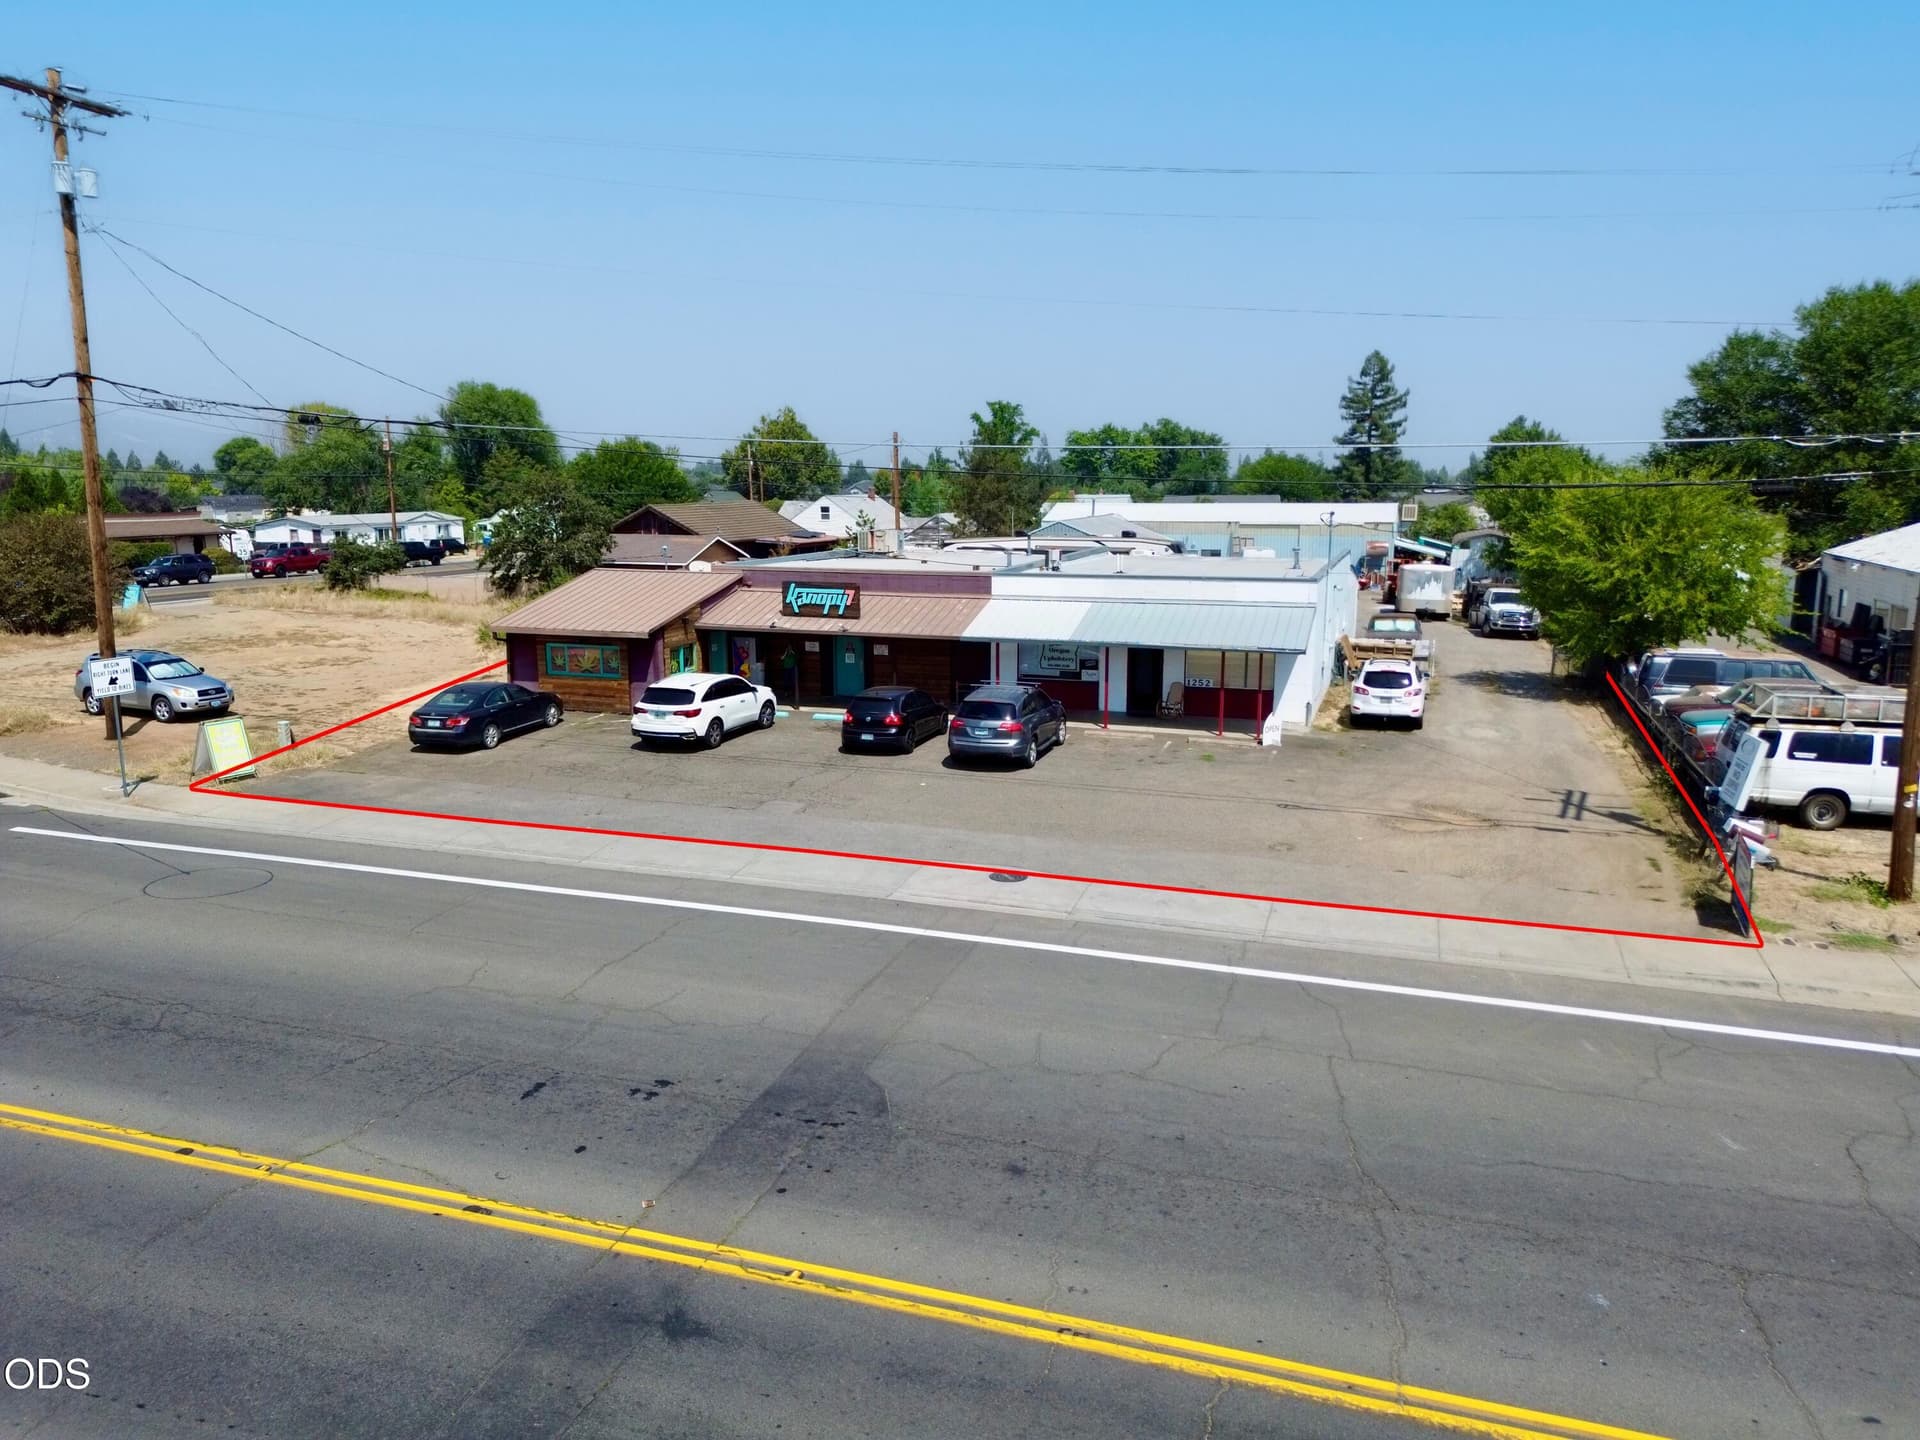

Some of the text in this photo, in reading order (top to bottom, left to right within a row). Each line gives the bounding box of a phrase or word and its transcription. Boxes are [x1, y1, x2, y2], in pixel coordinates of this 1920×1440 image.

[1186, 679, 1211, 687] 1252
[97, 686, 111, 694] YIELD
[1265, 725, 1280, 733] OPEN
